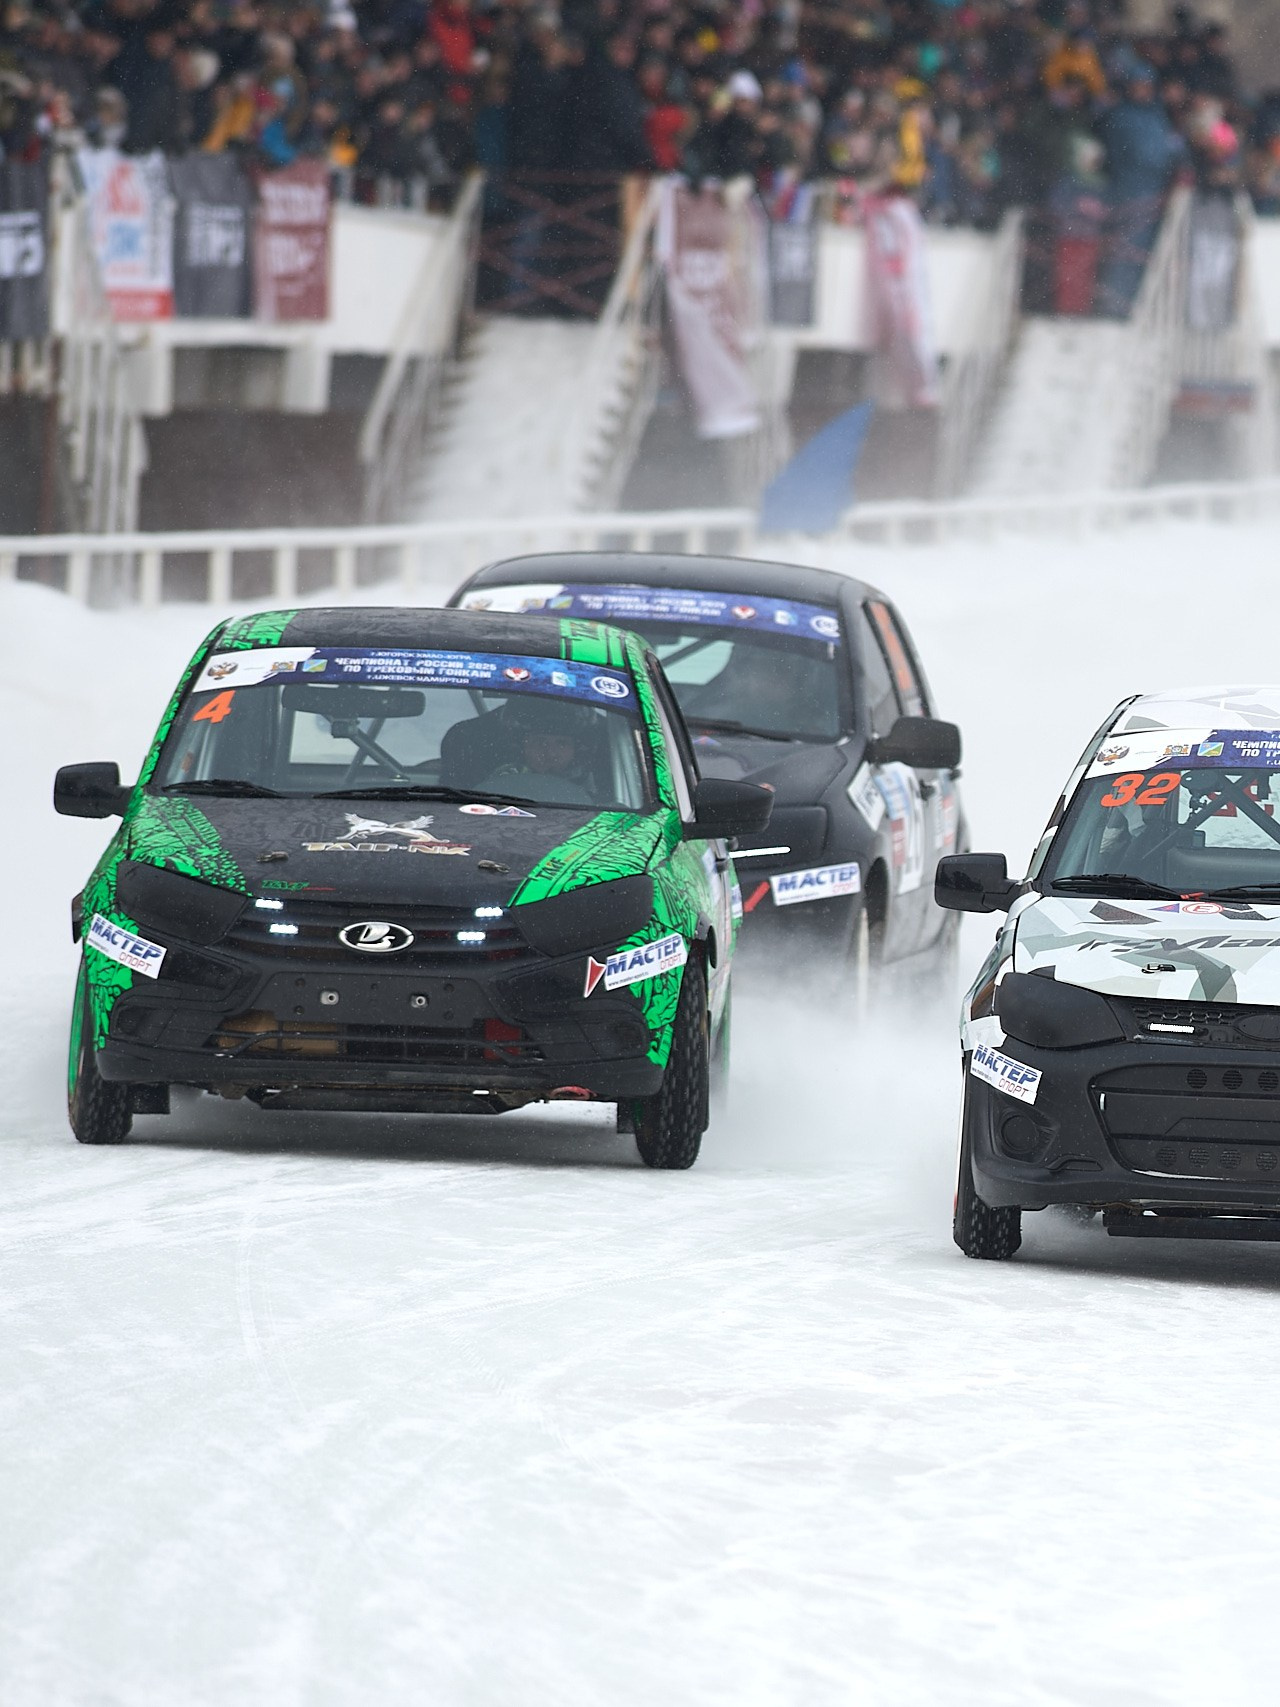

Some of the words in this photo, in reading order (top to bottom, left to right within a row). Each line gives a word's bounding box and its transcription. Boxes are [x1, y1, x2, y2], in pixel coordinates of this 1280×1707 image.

[334, 657, 410, 666] ЧЕМПИОНАТ
[416, 659, 464, 669] РОССИИ
[468, 662, 497, 671] 2025
[366, 666, 435, 675] ТРЕКОВЫМ
[439, 668, 492, 678] ГОНКАМ
[193, 690, 236, 724] 4
[1241, 749, 1259, 757] ПО
[1100, 772, 1182, 807] 32
[777, 866, 859, 892] МАСТЕР
[92, 917, 162, 960] МАСТЕР
[607, 935, 682, 976] МАСТЕР
[974, 1044, 1038, 1084] МАСТЕР
[998, 1078, 1029, 1097] СПОРТ
